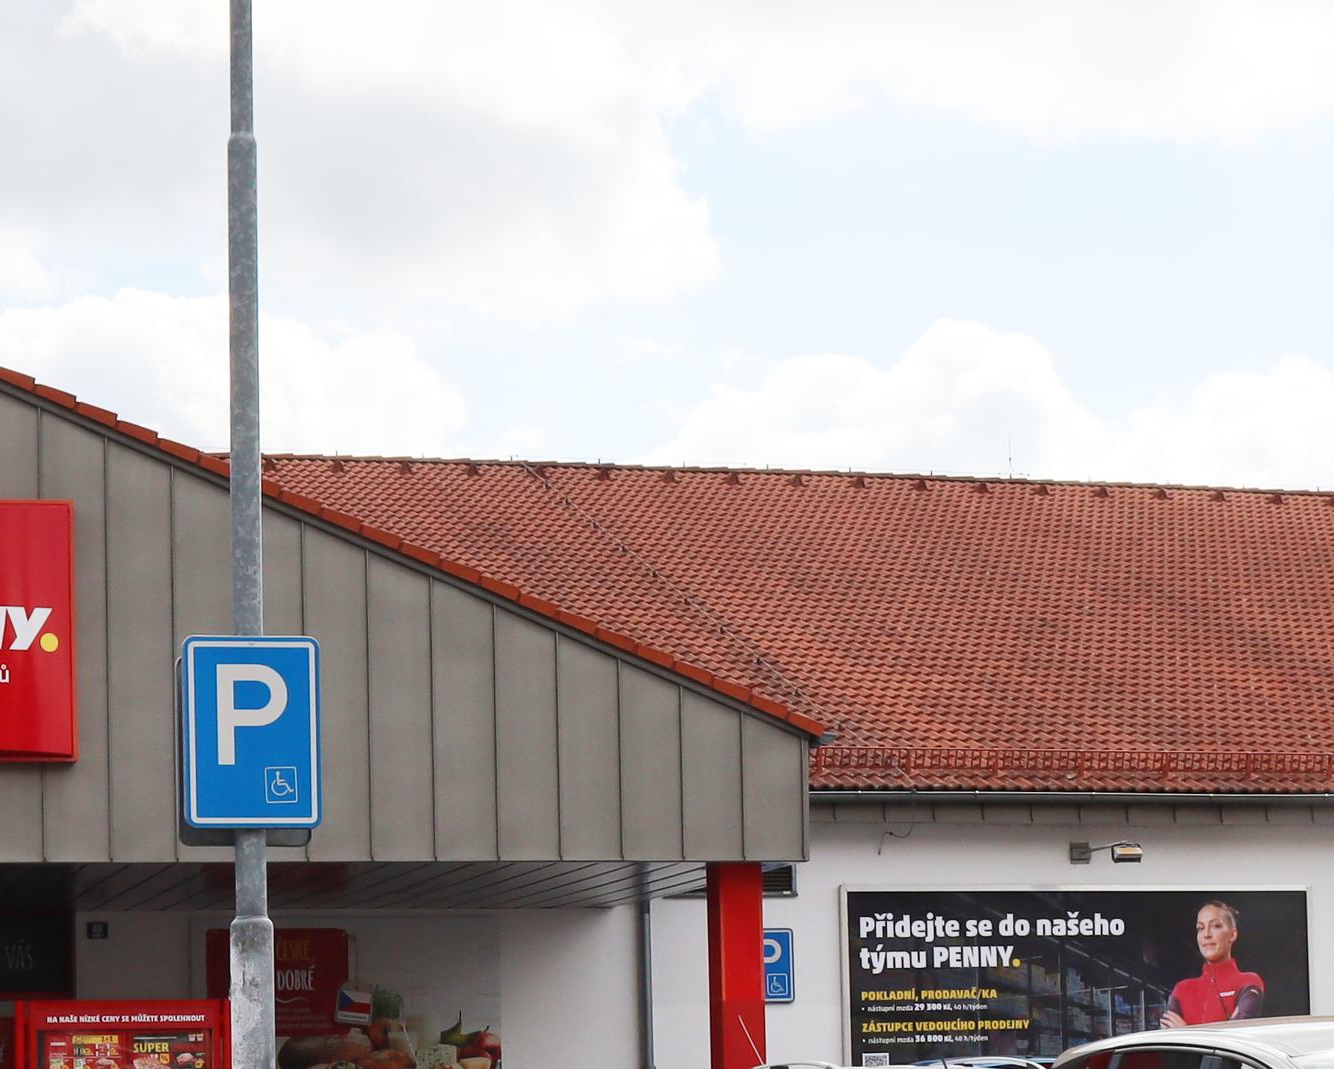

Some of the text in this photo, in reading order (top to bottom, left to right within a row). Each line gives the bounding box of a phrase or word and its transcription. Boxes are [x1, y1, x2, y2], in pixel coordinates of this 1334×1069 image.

[216, 663, 288, 766] P
[859, 911, 1125, 943] Přidejte se do našeho
[4, 937, 34, 971] VÁS
[859, 943, 1021, 975] týmu PENNY.
[861, 986, 998, 1002] POKLADNÍ, PRODAVAČ/KA
[47, 1016, 58, 1024] NA
[59, 1014, 78, 1023] NAŠE
[79, 1014, 101, 1023] NÍZKÉ
[102, 1015, 119, 1023] CENY
[131, 1013, 158, 1022] MŮŽETE
[160, 1014, 205, 1022] SPOLEHNOUT
[862, 1018, 1030, 1033] ZÁSTUPCE VEDOUCÍHO PRODEJNY
[132, 1042, 169, 1053] SUPER
